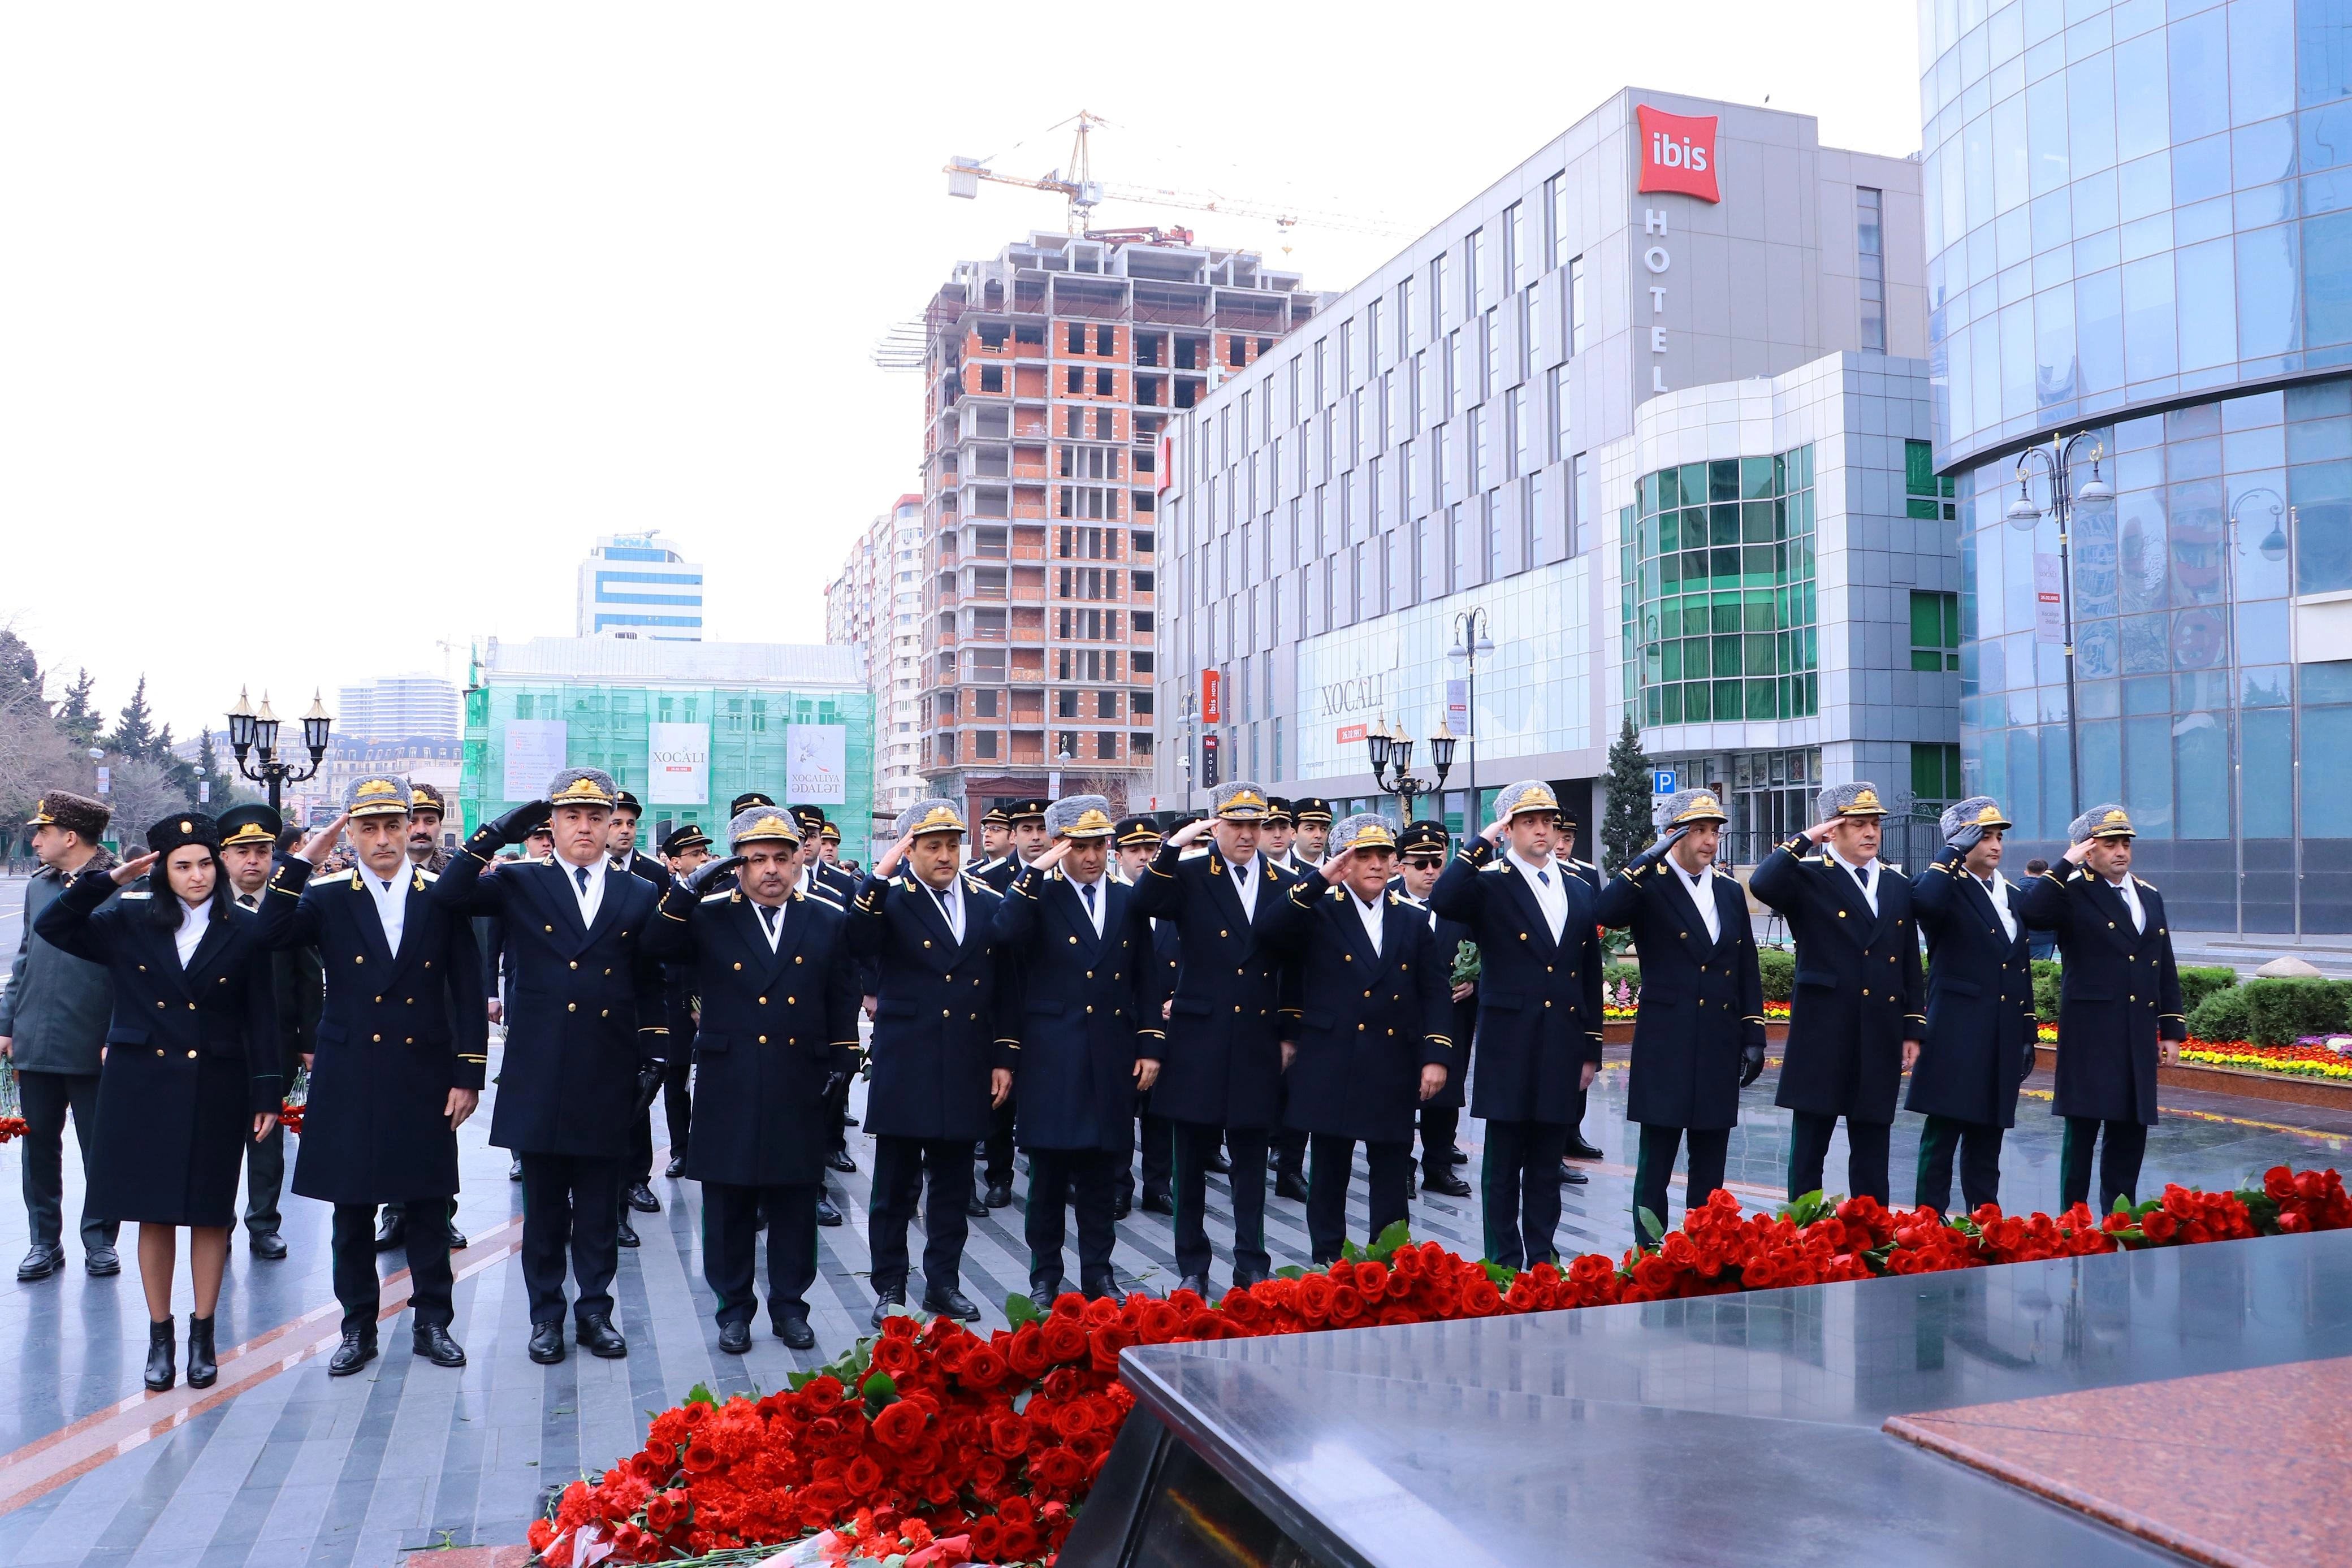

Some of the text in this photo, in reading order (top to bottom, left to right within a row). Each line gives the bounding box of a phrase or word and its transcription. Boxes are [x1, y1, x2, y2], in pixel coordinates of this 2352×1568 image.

[1653, 131, 1707, 172] ibis
[1644, 209, 1671, 393] HOTEL
[1321, 672, 1384, 717] XOCALI
[1342, 729, 1362, 740] 26.02.1992
[653, 752, 705, 763] XOCALI
[792, 774, 840, 782] XOCALIYA
[1659, 773, 1672, 792] P
[792, 783, 840, 793] ƏDALƏT
